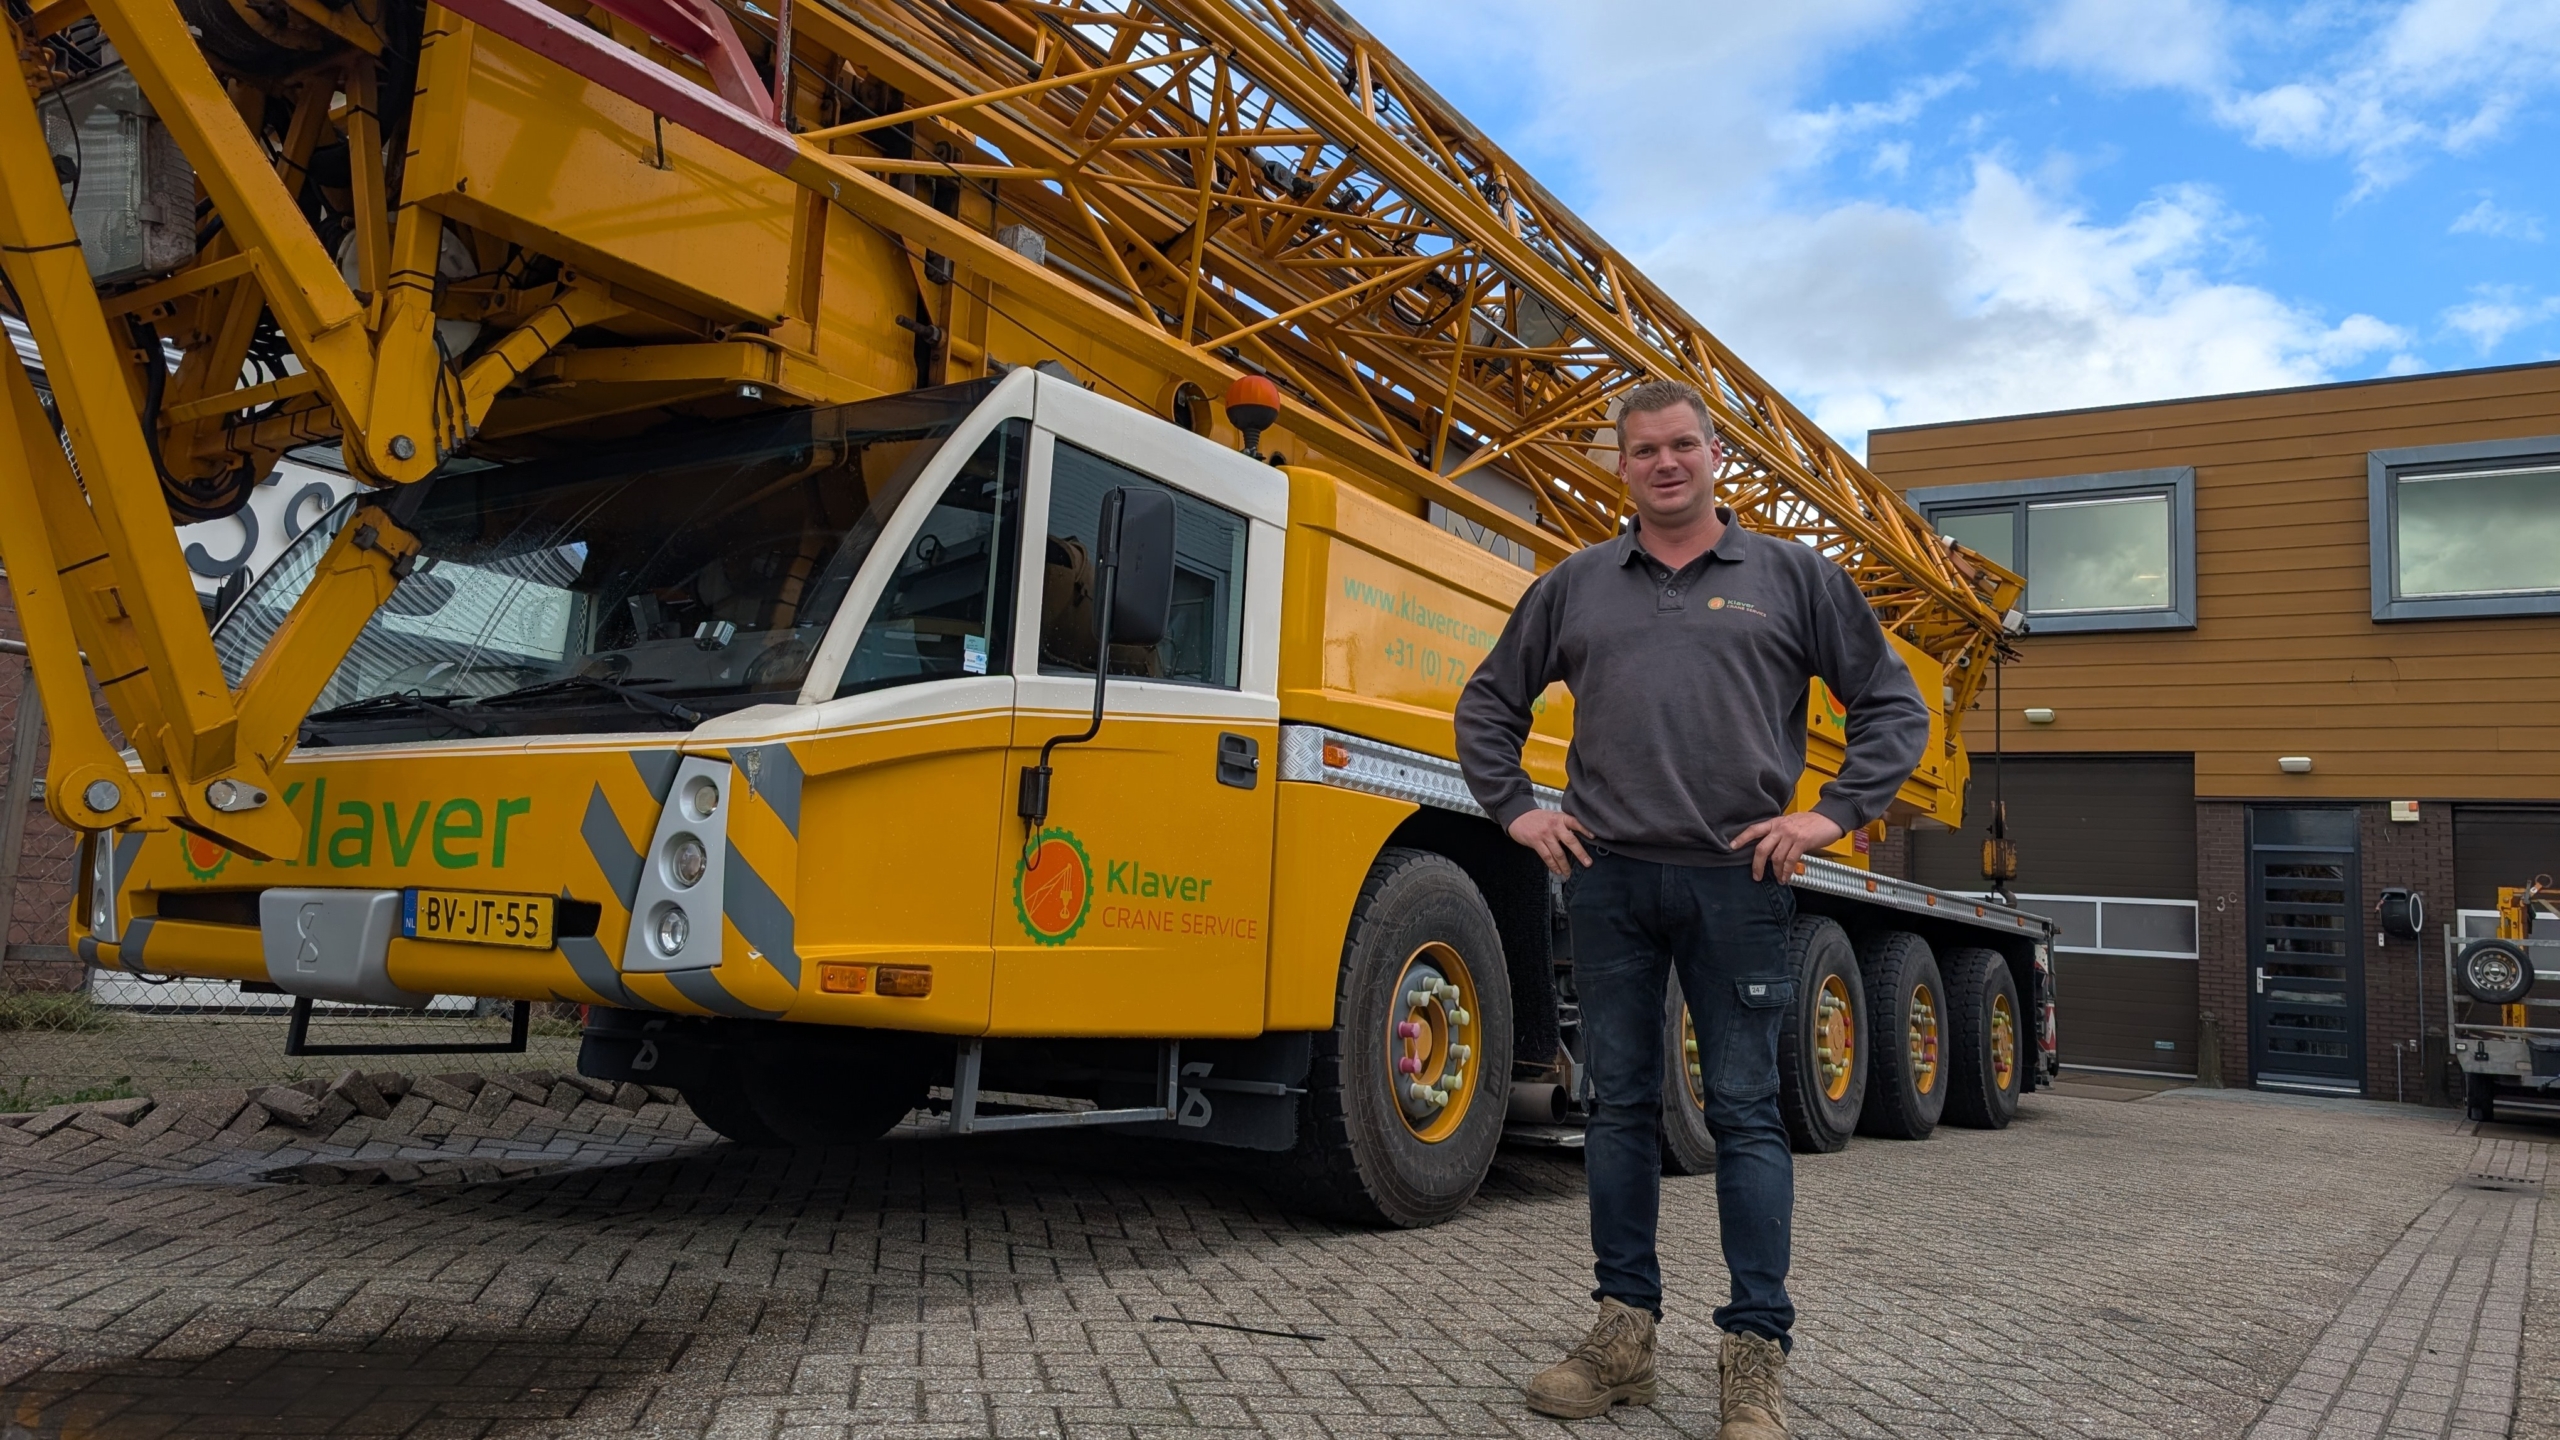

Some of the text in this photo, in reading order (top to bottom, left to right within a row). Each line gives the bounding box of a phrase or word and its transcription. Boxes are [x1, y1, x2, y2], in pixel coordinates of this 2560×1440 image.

[1727, 599, 1755, 609] Klaver
[1746, 607, 1767, 618] SERVICE
[1384, 637, 1414, 670] +31
[1420, 647, 1442, 687] (0)
[1447, 656, 1467, 688] 72
[1106, 859, 1213, 903] Klaver
[405, 896, 539, 939] NL BV-JT-55
[1102, 906, 1258, 940] CRANE SERVICE
